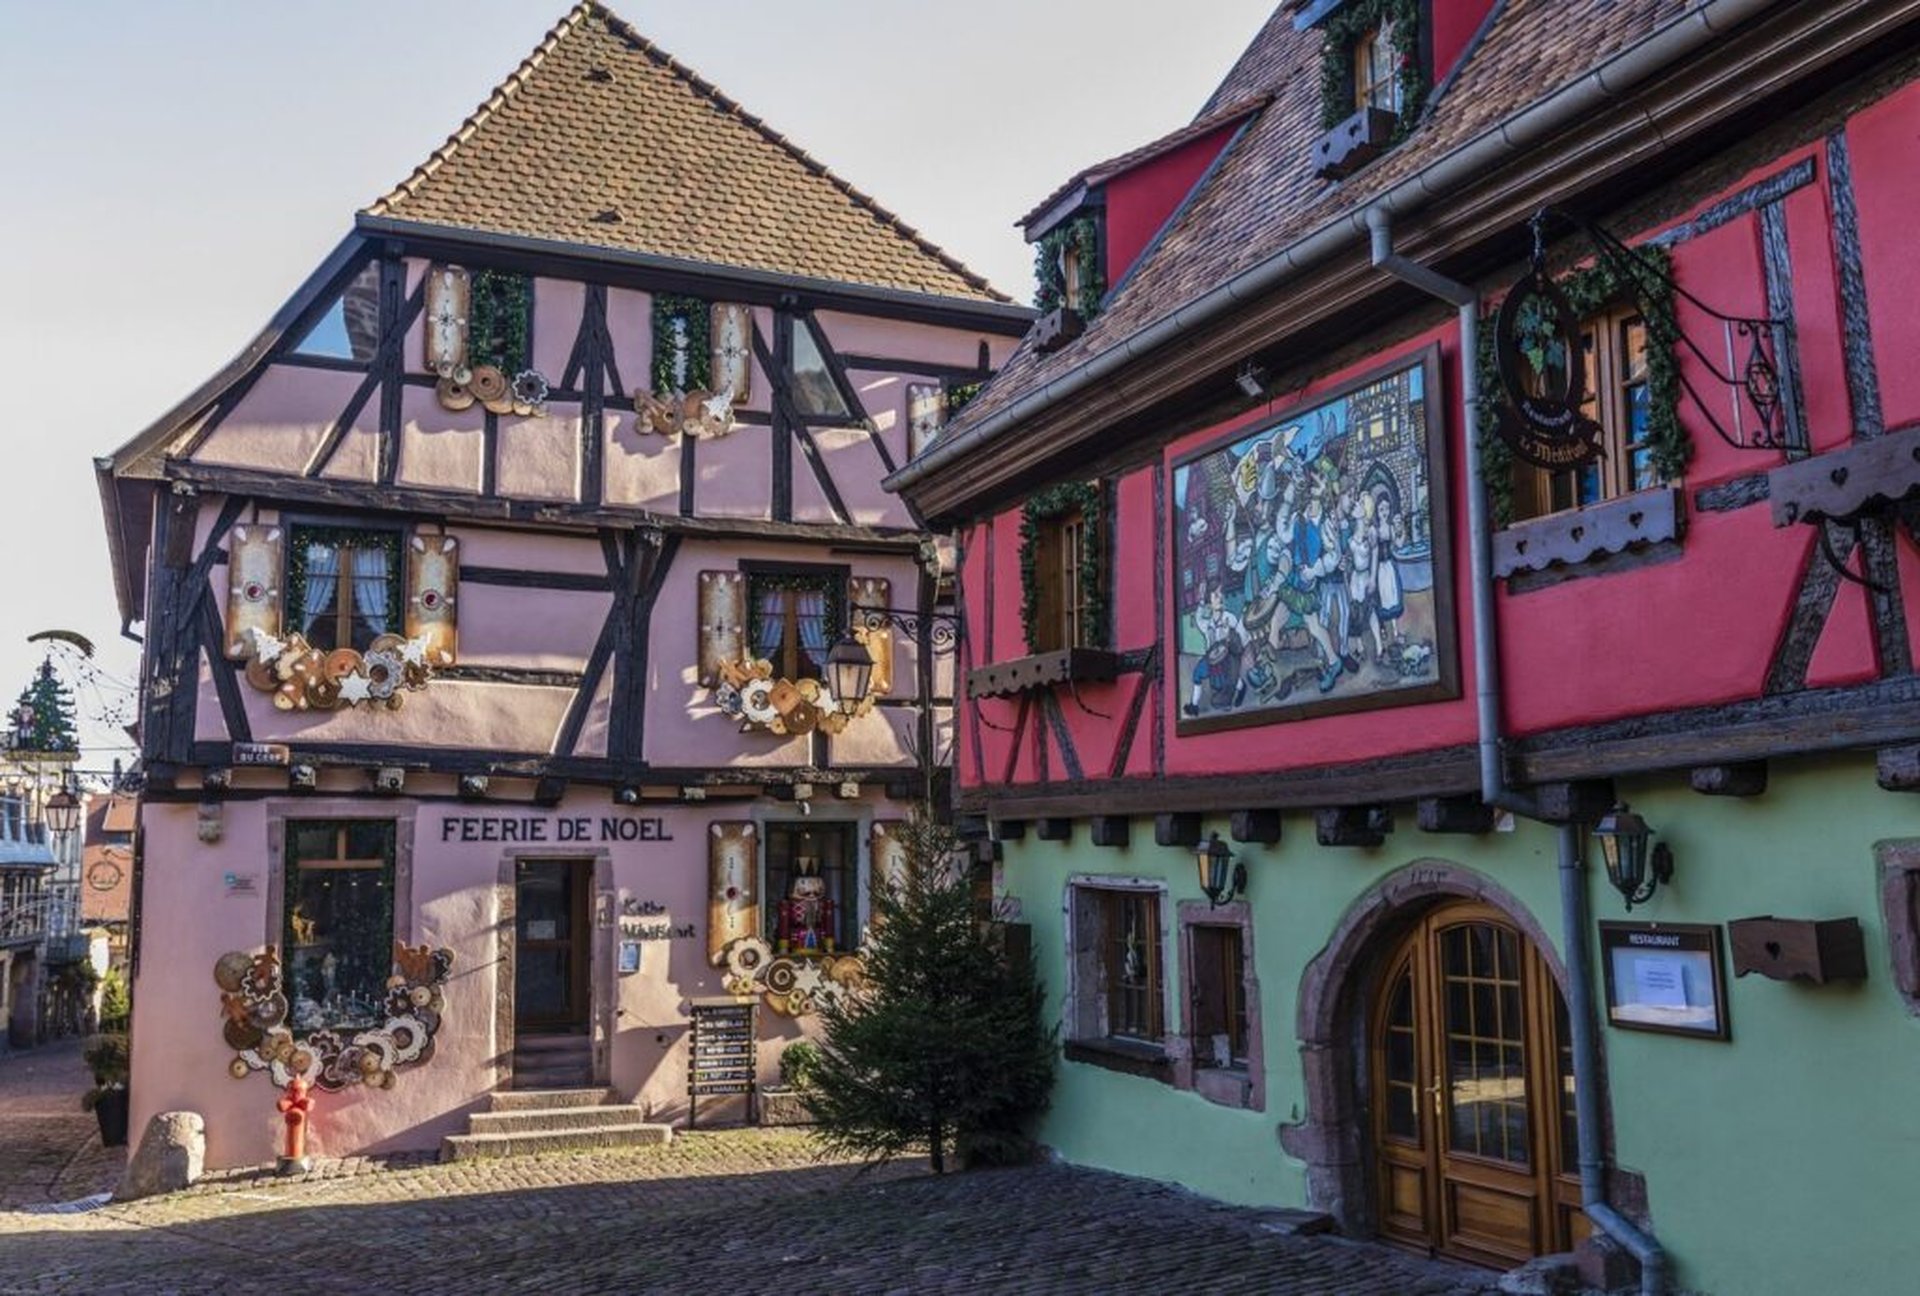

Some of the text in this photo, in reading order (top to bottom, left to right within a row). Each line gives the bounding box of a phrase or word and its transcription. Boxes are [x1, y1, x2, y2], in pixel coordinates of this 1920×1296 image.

[442, 817, 674, 842] FEERIE DE NOEL
